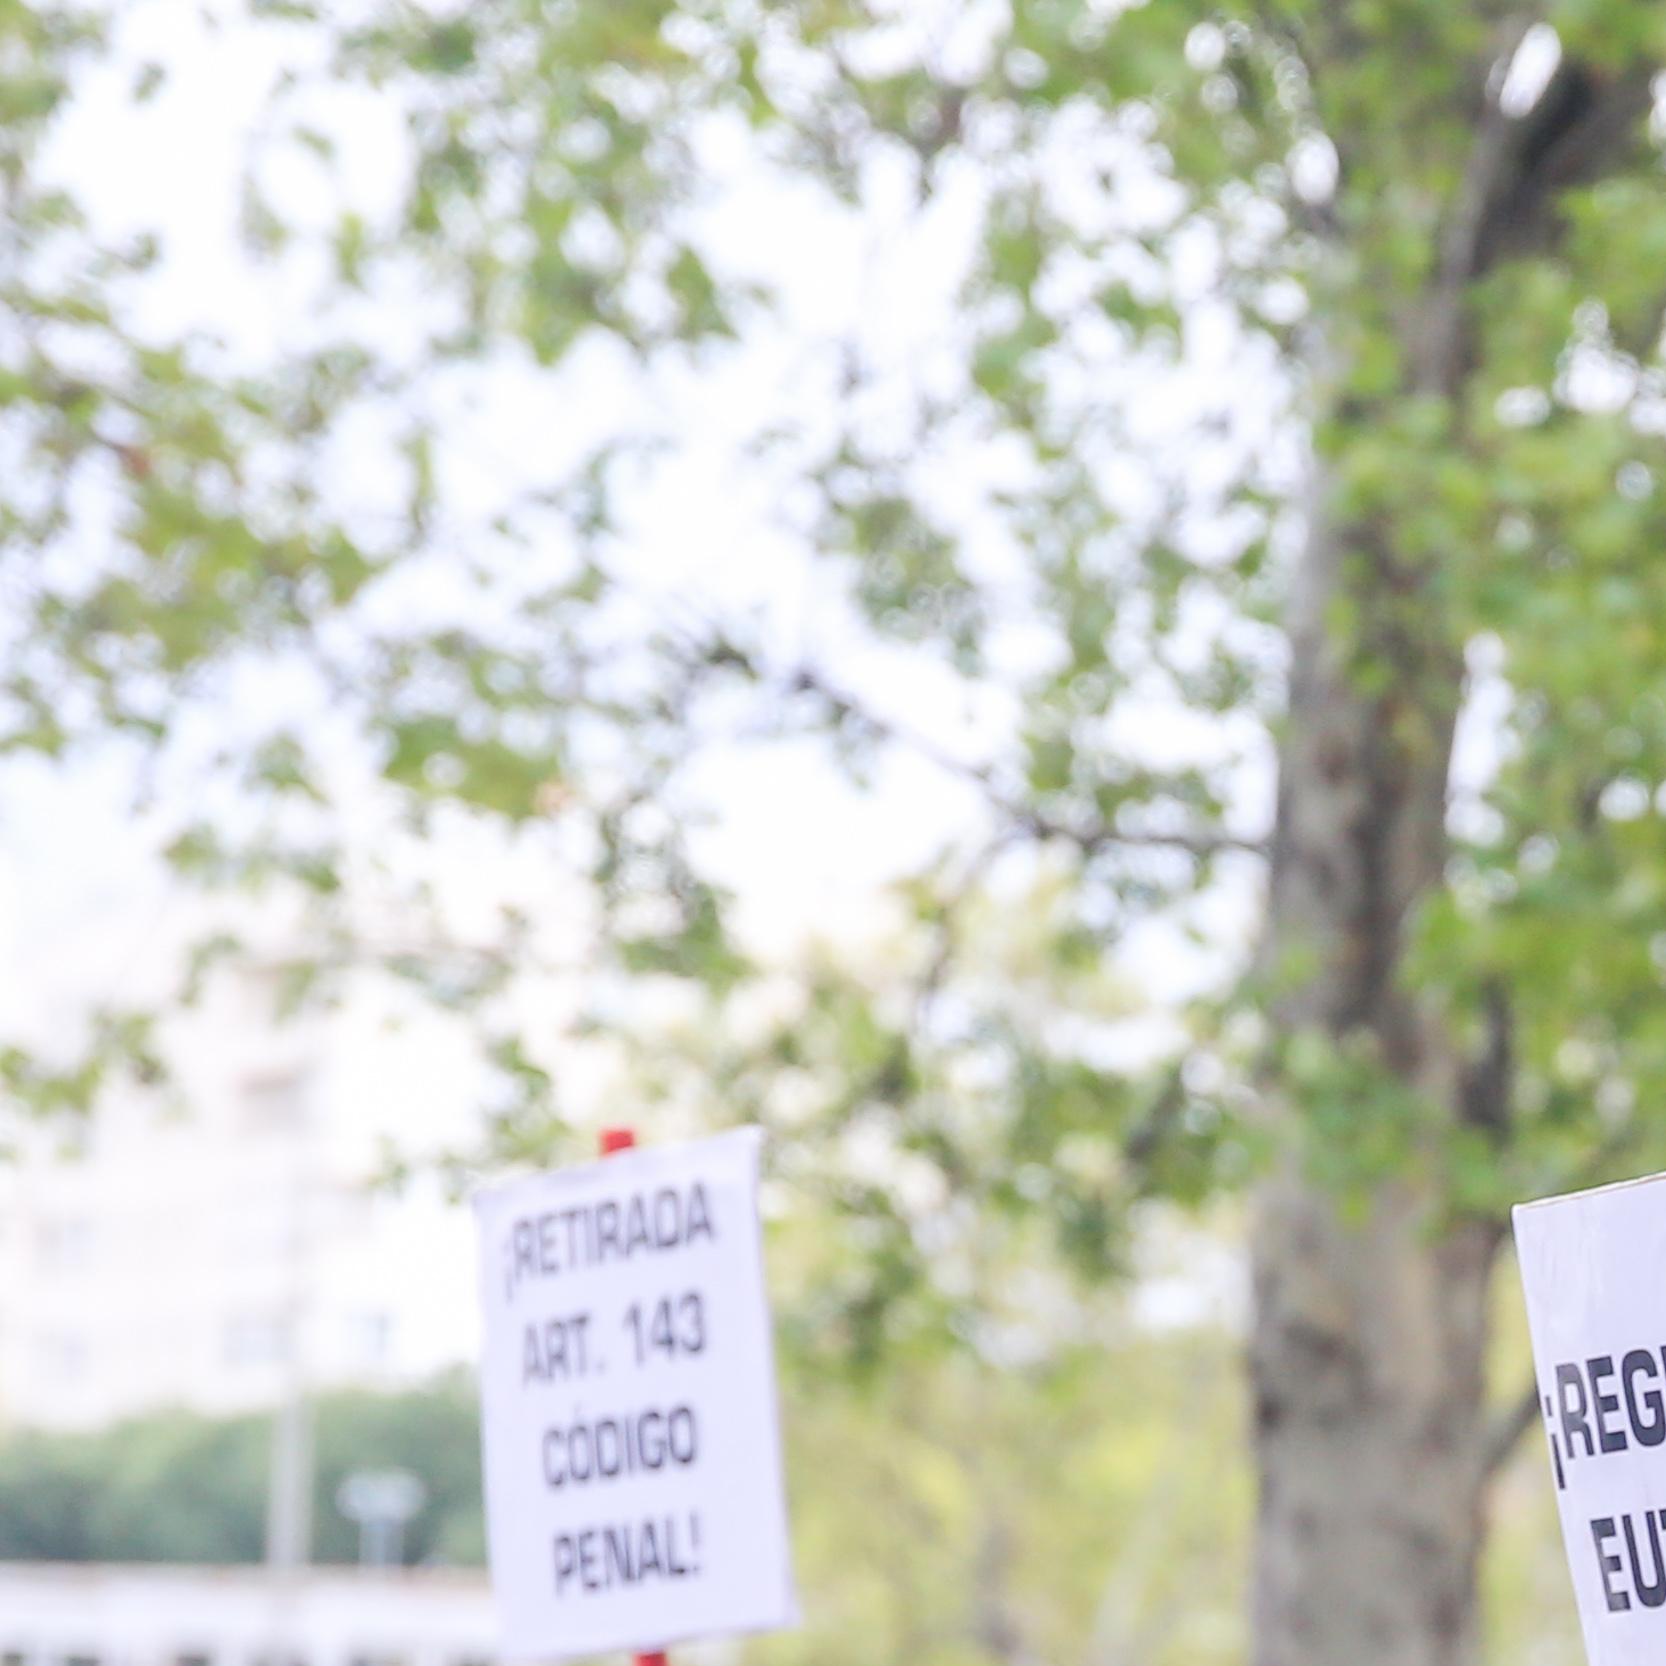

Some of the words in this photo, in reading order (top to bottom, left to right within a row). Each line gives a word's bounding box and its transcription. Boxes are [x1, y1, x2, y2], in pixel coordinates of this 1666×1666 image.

[506, 1182, 714, 1298] ¡RETIRADA
[522, 1314, 606, 1386] ART.
[624, 1292, 707, 1367] 143
[541, 1400, 697, 1489] CÓDIGO
[552, 1513, 702, 1597] PENAL!
